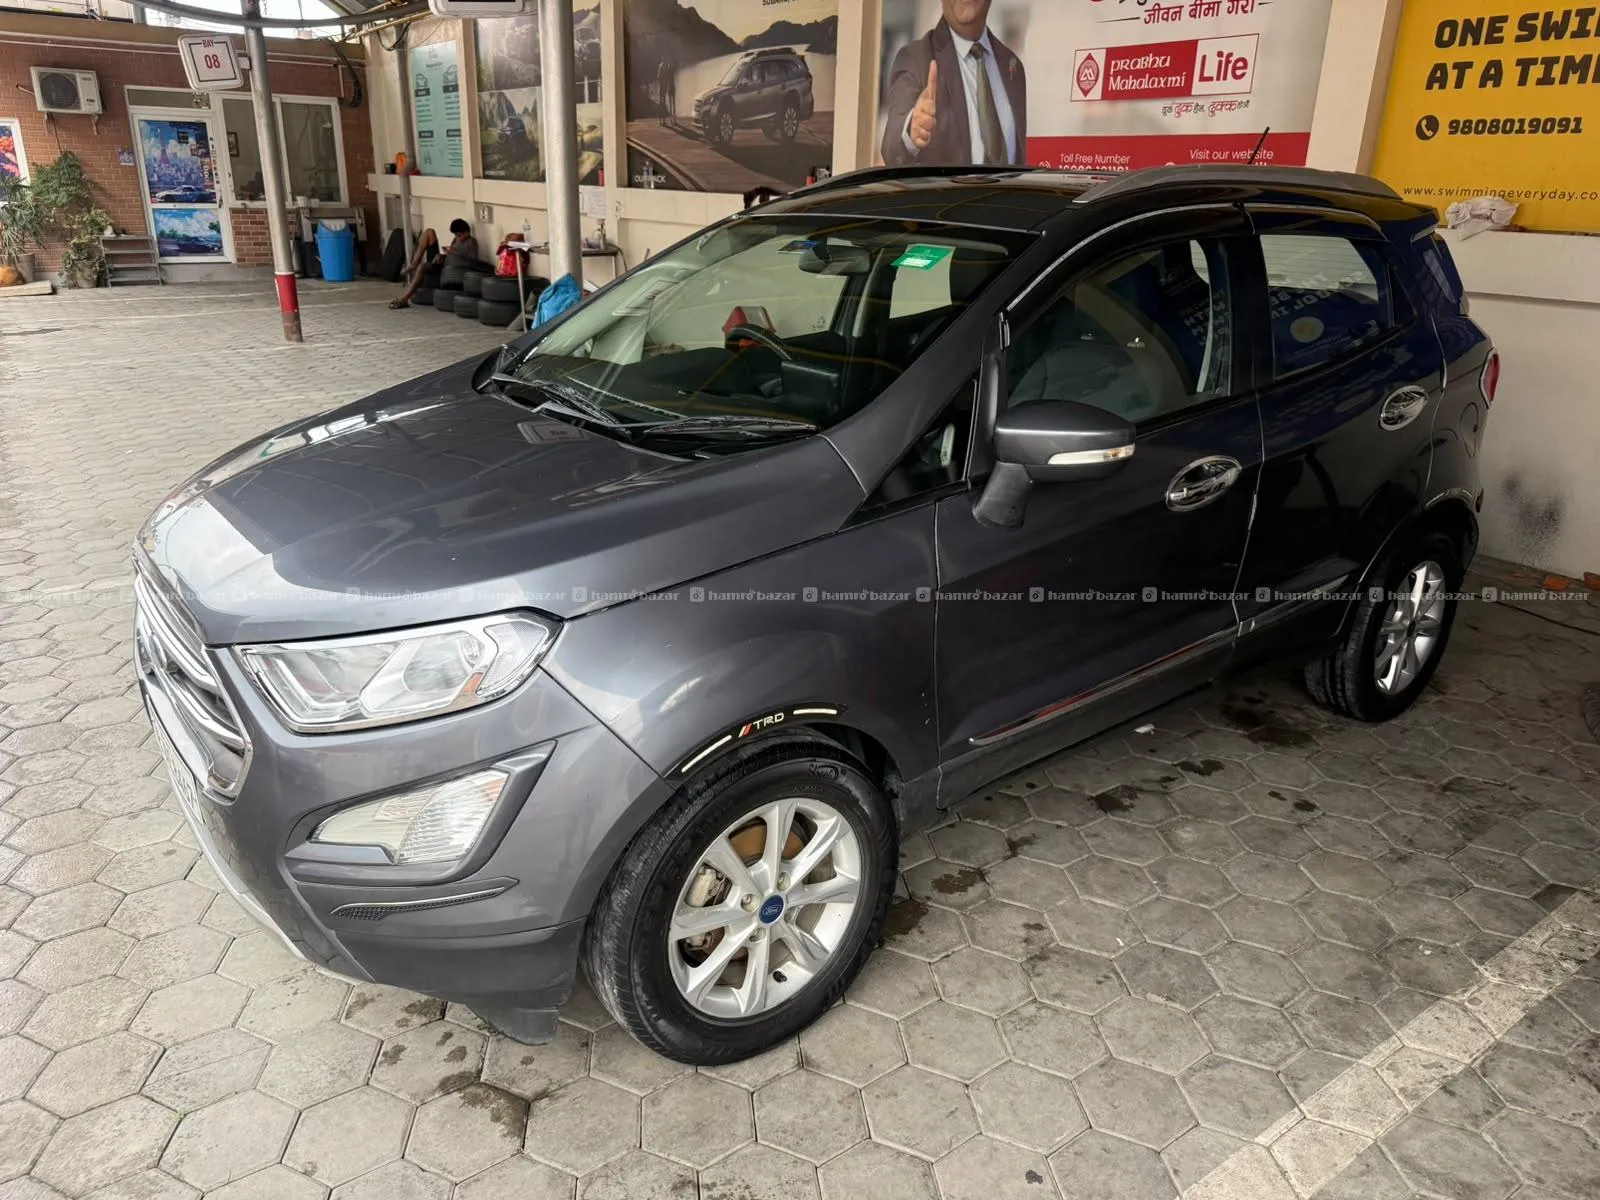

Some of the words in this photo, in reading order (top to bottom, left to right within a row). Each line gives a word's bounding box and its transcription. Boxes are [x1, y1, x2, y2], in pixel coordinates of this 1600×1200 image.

[1144, 3, 1184, 24] जीवन
[1434, 15, 1509, 48] ONE
[1514, 7, 1600, 43] SWI
[204, 54, 220, 69] 08
[1198, 51, 1249, 83] Life
[1108, 72, 1186, 91] Mahalaxmi
[1425, 61, 1473, 90] AT
[1478, 59, 1503, 88] A
[1448, 117, 1583, 135] 9808019091
[1060, 153, 1074, 163] Toll
[1075, 153, 1093, 163] Free
[1095, 154, 1131, 164] Number
[1190, 149, 1210, 160] Visit
[1212, 151, 1229, 160] our
[753, 712, 785, 730] TRD
